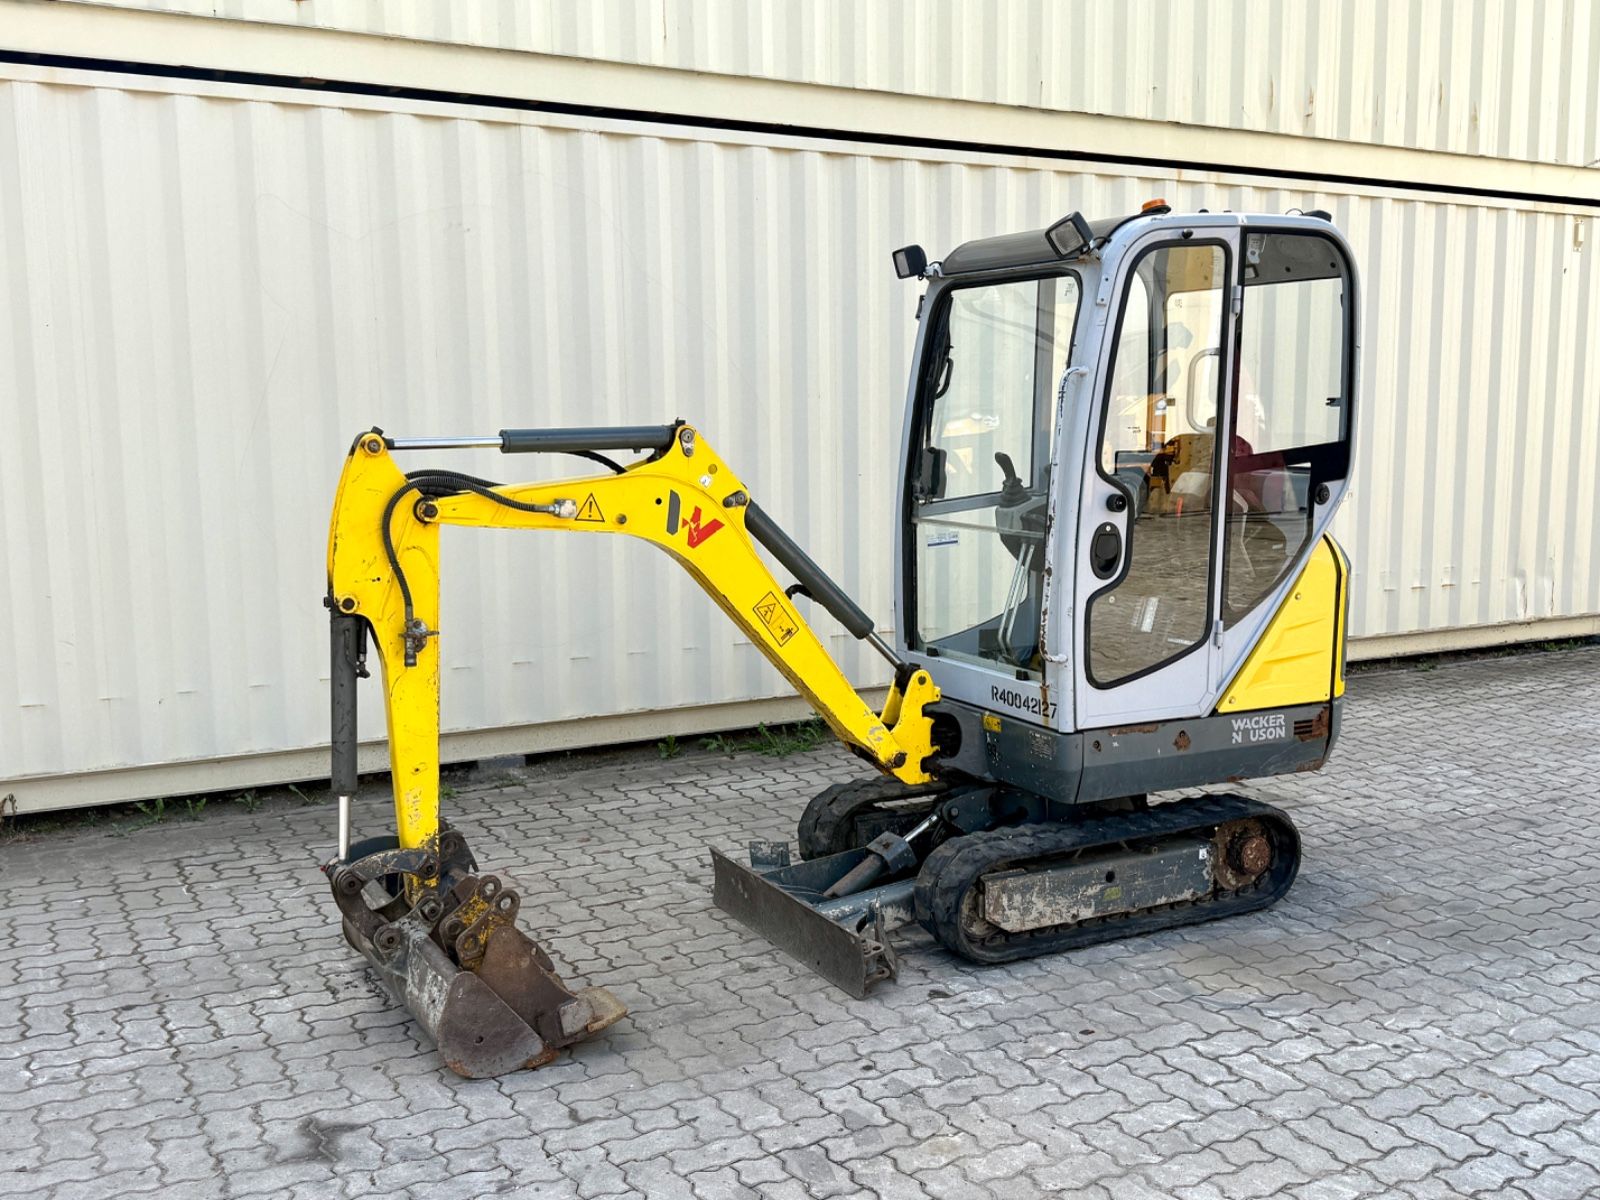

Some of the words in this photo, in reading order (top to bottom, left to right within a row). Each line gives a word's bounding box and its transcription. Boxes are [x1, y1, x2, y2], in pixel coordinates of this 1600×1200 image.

[991, 685, 1057, 719] R40042127
[1231, 714, 1286, 731] WACKER
[1231, 726, 1286, 744] NUSON
